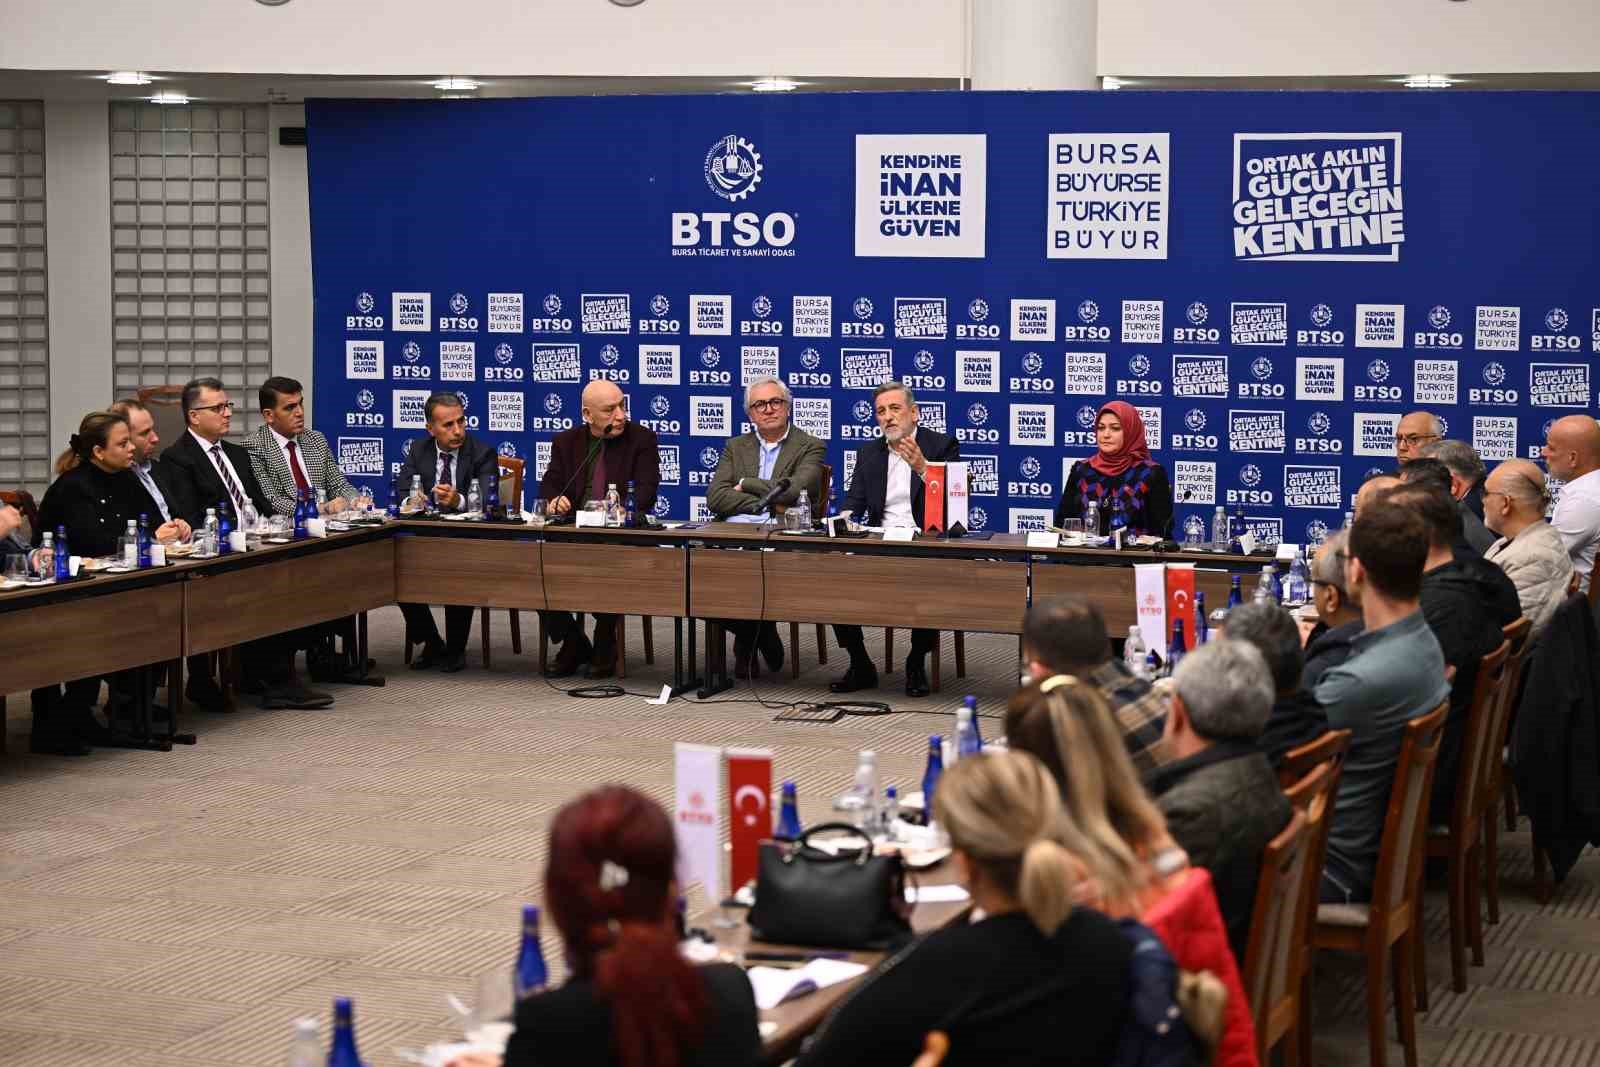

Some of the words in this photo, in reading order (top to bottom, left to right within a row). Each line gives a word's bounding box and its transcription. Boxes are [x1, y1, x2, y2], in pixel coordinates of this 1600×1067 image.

[1057, 144, 1160, 164] BURSA
[1246, 152, 1316, 174] ORTAK
[1322, 146, 1386, 168] AKLIN
[880, 155, 961, 168] KENDİNE
[880, 172, 961, 196] İNAN
[1057, 173, 1160, 192] BÜYÜRSE
[880, 200, 960, 215] ÜLKENE
[1056, 201, 1160, 221] TÜRKİYE
[672, 212, 795, 247] BTSO
[880, 218, 960, 236] GÜVEN
[1054, 230, 1158, 249] BÜYÜR
[347, 317, 383, 328] BTSO
[440, 318, 478, 329] BTSO
[533, 319, 572, 331] BTSO
[640, 320, 680, 332] BTSO
[741, 321, 782, 333] BTSO
[842, 323, 884, 335] BTSO
[957, 325, 1000, 337] BTSO
[1066, 327, 1110, 339] BTSO
[1174, 329, 1219, 341] BTSO
[1297, 331, 1344, 344] BTSO
[1415, 333, 1462, 346] BTSO
[1532, 336, 1580, 349] BTSO
[1068, 355, 1102, 363] BURSA
[393, 366, 430, 377] BTSO
[485, 368, 523, 379] BTSO
[590, 369, 630, 381] BTSO
[690, 371, 730, 383] BTSO
[789, 373, 831, 384] BTSO
[903, 376, 946, 388] BTSO
[1010, 378, 1054, 391] BTSO
[1117, 381, 1161, 393] BTSO
[1239, 384, 1284, 397] BTSO
[1355, 386, 1401, 399] BTSO
[1470, 389, 1517, 403] BTSO
[347, 413, 384, 425] BTSO
[534, 418, 572, 430] BTSO
[1477, 420, 1515, 429] BURSA
[956, 429, 999, 442] BTSO
[1065, 432, 1096, 443] BTS
[1173, 435, 1217, 448] BTSO
[1296, 439, 1342, 452] BTSO
[1177, 465, 1213, 473] BURSA
[1008, 483, 1051, 495] BTSO
[1176, 493, 1212, 501] BYÜR
[1227, 491, 1272, 503] BTSO
